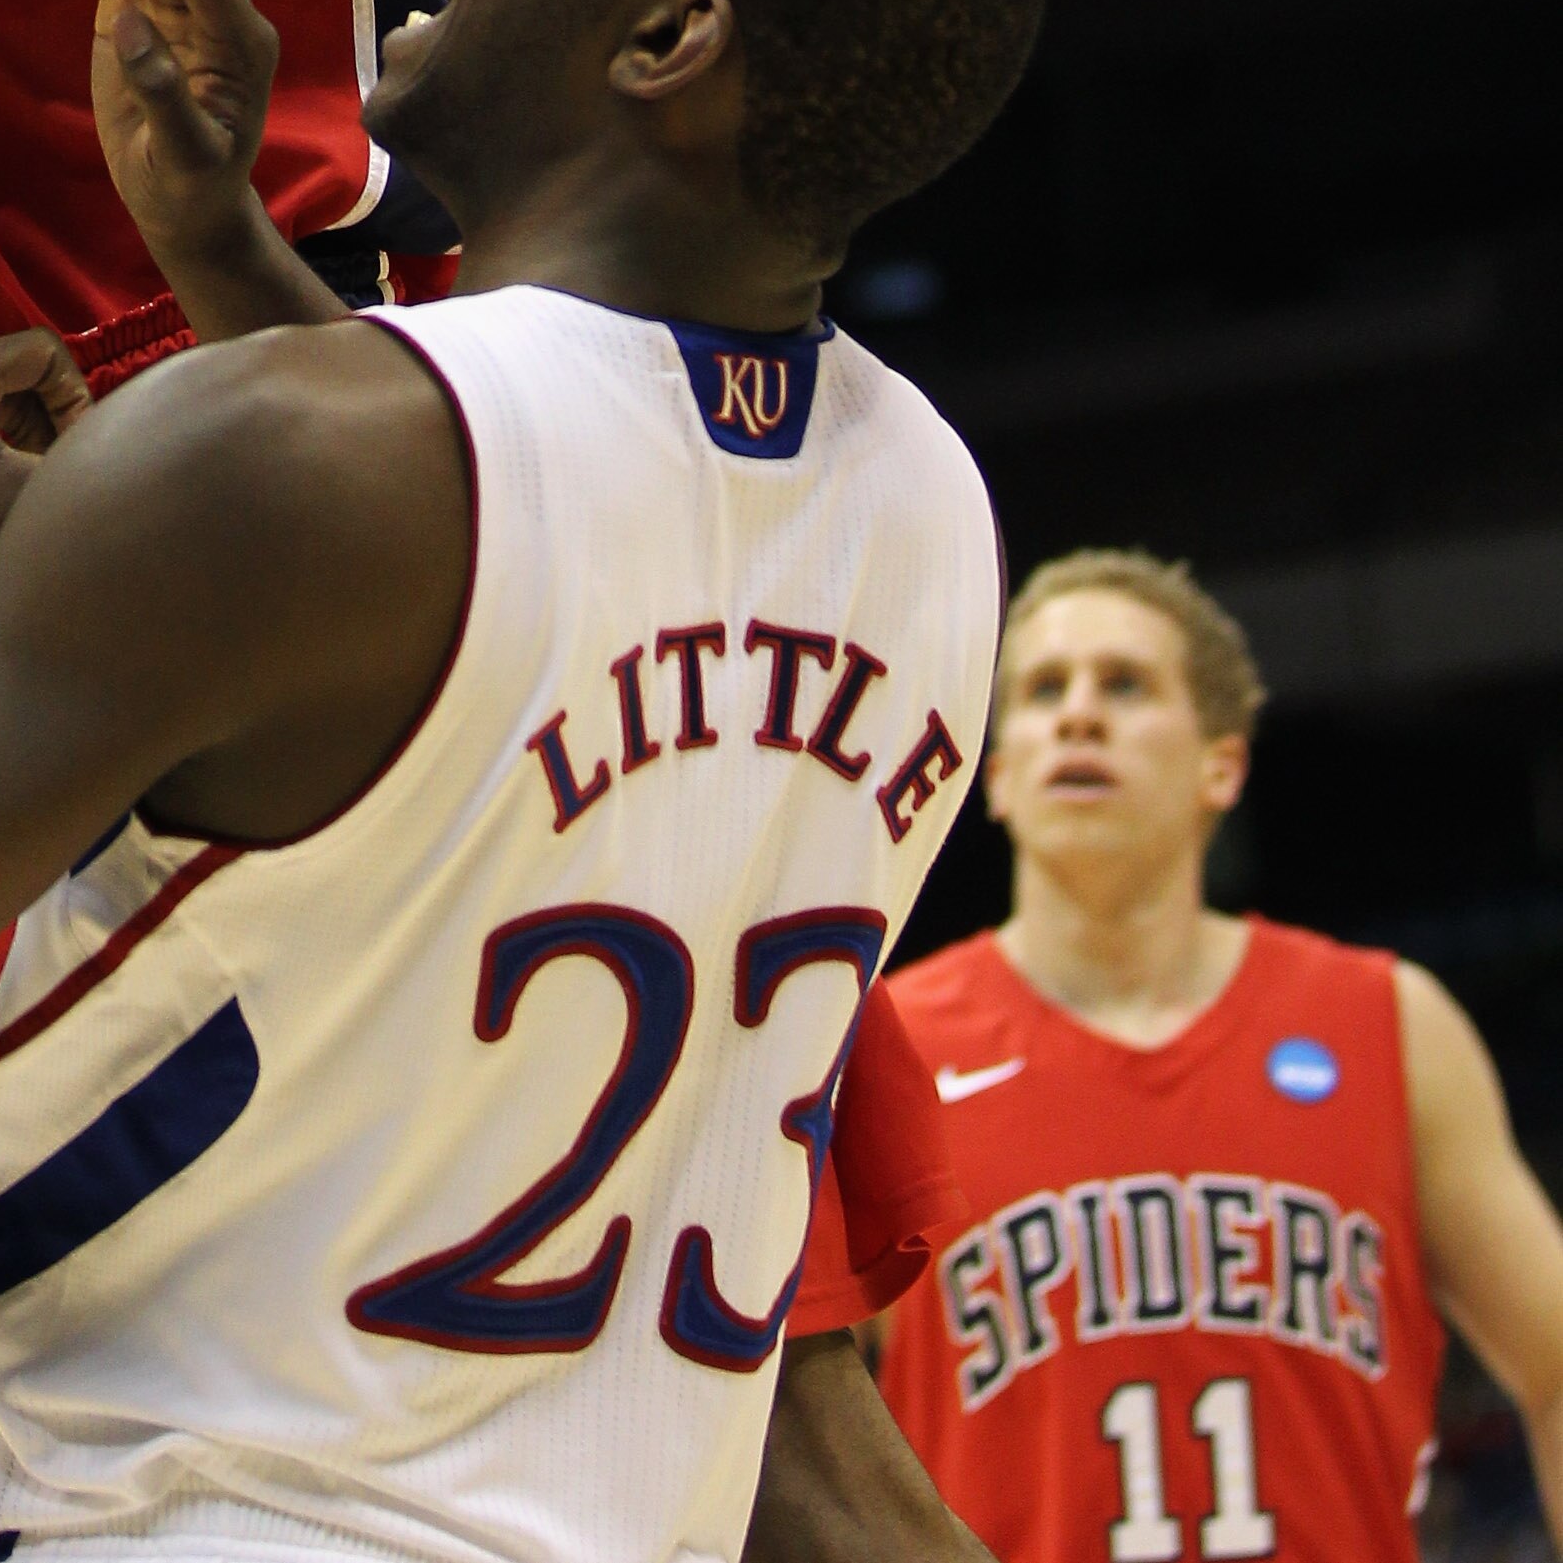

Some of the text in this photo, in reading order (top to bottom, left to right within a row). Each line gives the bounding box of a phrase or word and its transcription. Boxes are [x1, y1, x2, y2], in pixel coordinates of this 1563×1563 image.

[712, 354, 789, 439] KU
[526, 619, 962, 845] LITTLE
[345, 902, 888, 1372] 23
[940, 1172, 1389, 1415] SPIDERS
[1100, 1375, 1277, 1563] 11
